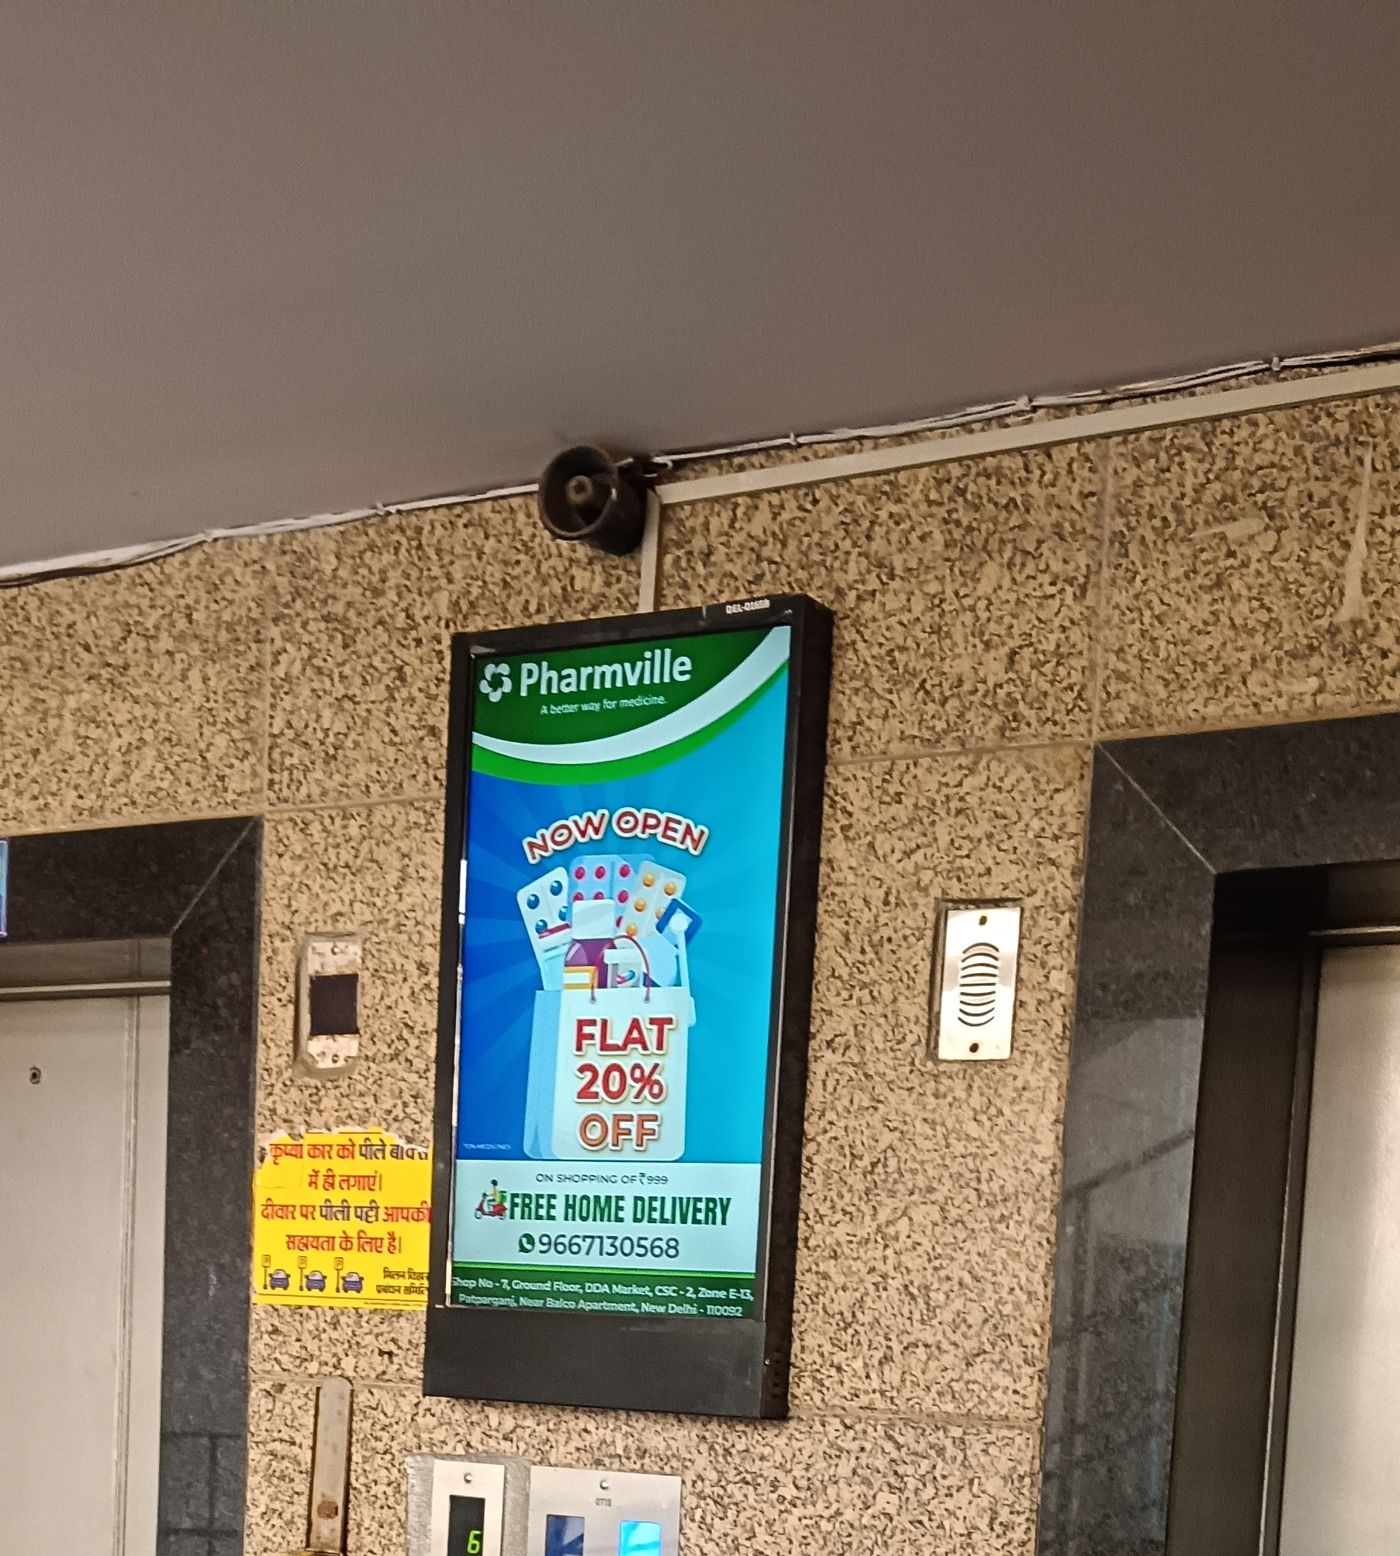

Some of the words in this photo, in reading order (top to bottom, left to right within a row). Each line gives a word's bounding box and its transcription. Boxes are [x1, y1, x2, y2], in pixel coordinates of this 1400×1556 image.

[520, 648, 693, 697] Pharmville
[540, 705, 549, 715] A
[550, 703, 580, 714] better
[581, 701, 601, 713] way
[603, 698, 617, 710] for
[619, 694, 667, 708] medicine.
[524, 811, 608, 862] NOW
[614, 809, 709, 855] OPEN
[575, 1017, 674, 1054] FLAT
[575, 1062, 665, 1101] 20%
[579, 1113, 660, 1148] OFF
[306, 1143, 333, 1160] कार
[336, 1138, 356, 1160] को
[358, 1137, 387, 1161] पीले
[308, 1168, 320, 1191] में
[322, 1168, 336, 1192] ही
[535, 1173, 554, 1183] ON
[556, 1174, 618, 1185] SHOPPING
[260, 1197, 297, 1221] दीवार
[299, 1203, 317, 1221] पर
[319, 1198, 351, 1222] पीली
[354, 1199, 380, 1224] पट्टी
[382, 1200, 432, 1224] आपकी
[509, 1192, 557, 1221] FREE
[563, 1194, 626, 1223] HOME
[633, 1195, 732, 1226] DELIVERY
[285, 1234, 336, 1252] सहायता
[339, 1230, 354, 1251] के
[356, 1229, 385, 1254] लिए
[538, 1233, 681, 1259] 9667130568
[478, 1278, 494, 1289] No
[511, 1280, 552, 1291] Ground
[553, 1281, 584, 1294] Floor,
[584, 1282, 612, 1294] DDA
[612, 1284, 654, 1297] Market,
[654, 1286, 679, 1297] CSC
[697, 1287, 728, 1299] Zone
[519, 1296, 545, 1308] Near
[545, 1297, 577, 1309] Balco
[577, 1299, 640, 1314] Apartment,
[640, 1302, 667, 1313] New
[667, 1303, 698, 1315] Delhi
[706, 1304, 744, 1317] 110092
[466, 1530, 482, 1554] 6
